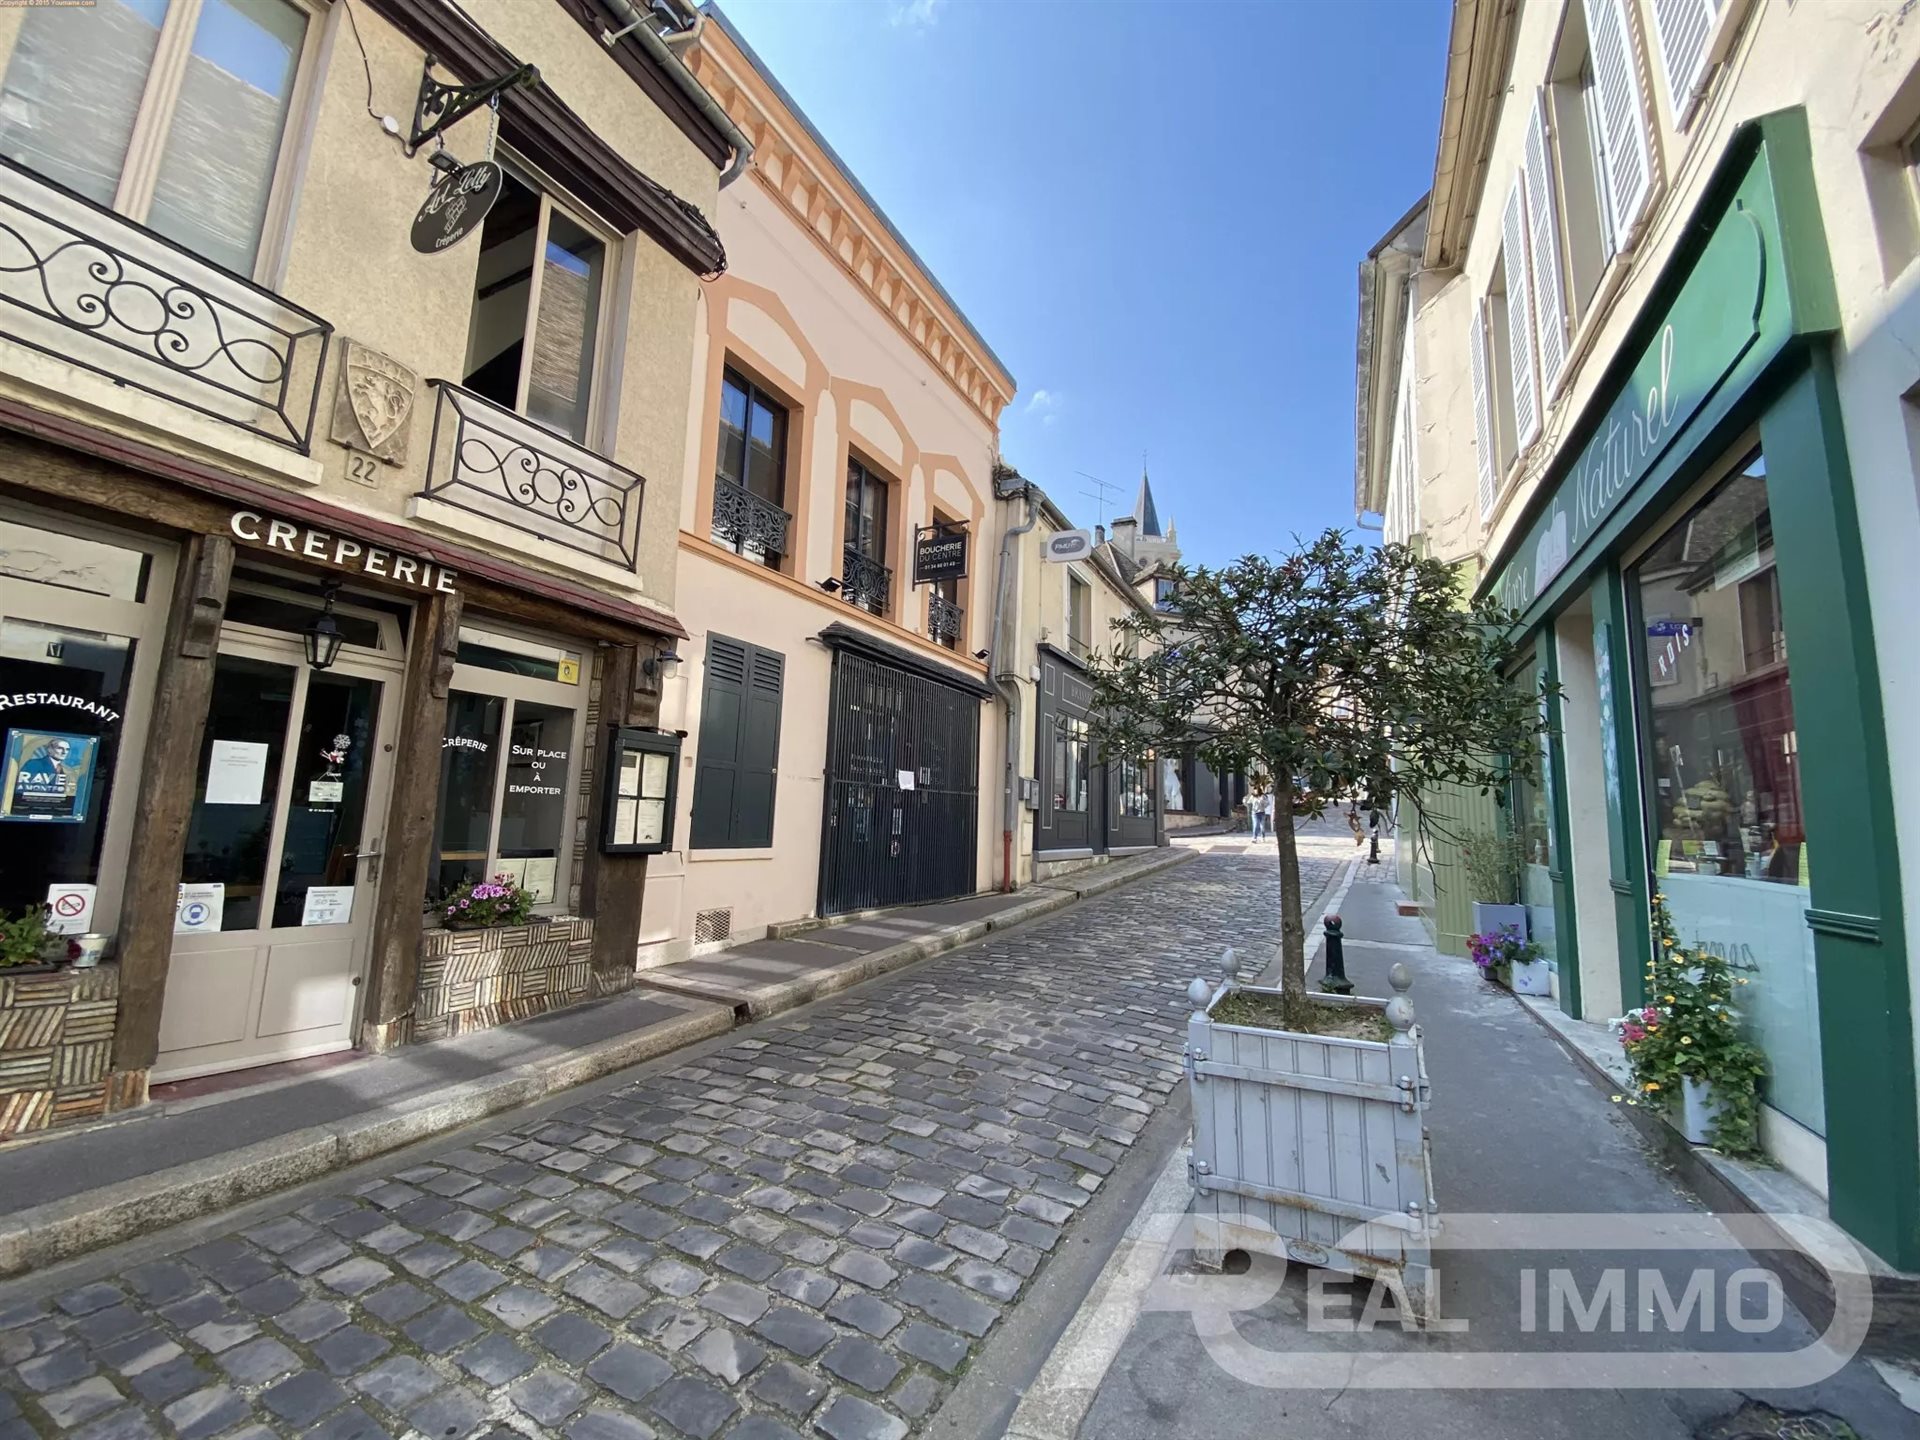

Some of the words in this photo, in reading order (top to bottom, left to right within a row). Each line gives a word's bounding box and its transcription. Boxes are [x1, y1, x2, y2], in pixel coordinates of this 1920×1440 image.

[1571, 324, 1679, 544] Naturel
[351, 456, 376, 482] 22
[230, 510, 459, 595] CREPERIE
[919, 541, 962, 555] BOUCHERIE
[932, 550, 961, 561] CENTRE
[0, 692, 120, 722] RESTAURANT
[512, 744, 534, 756] SUR
[537, 749, 567, 760] PLACE
[531, 761, 546, 769] OU
[533, 770, 541, 782] À
[509, 785, 561, 795] EMPORTER
